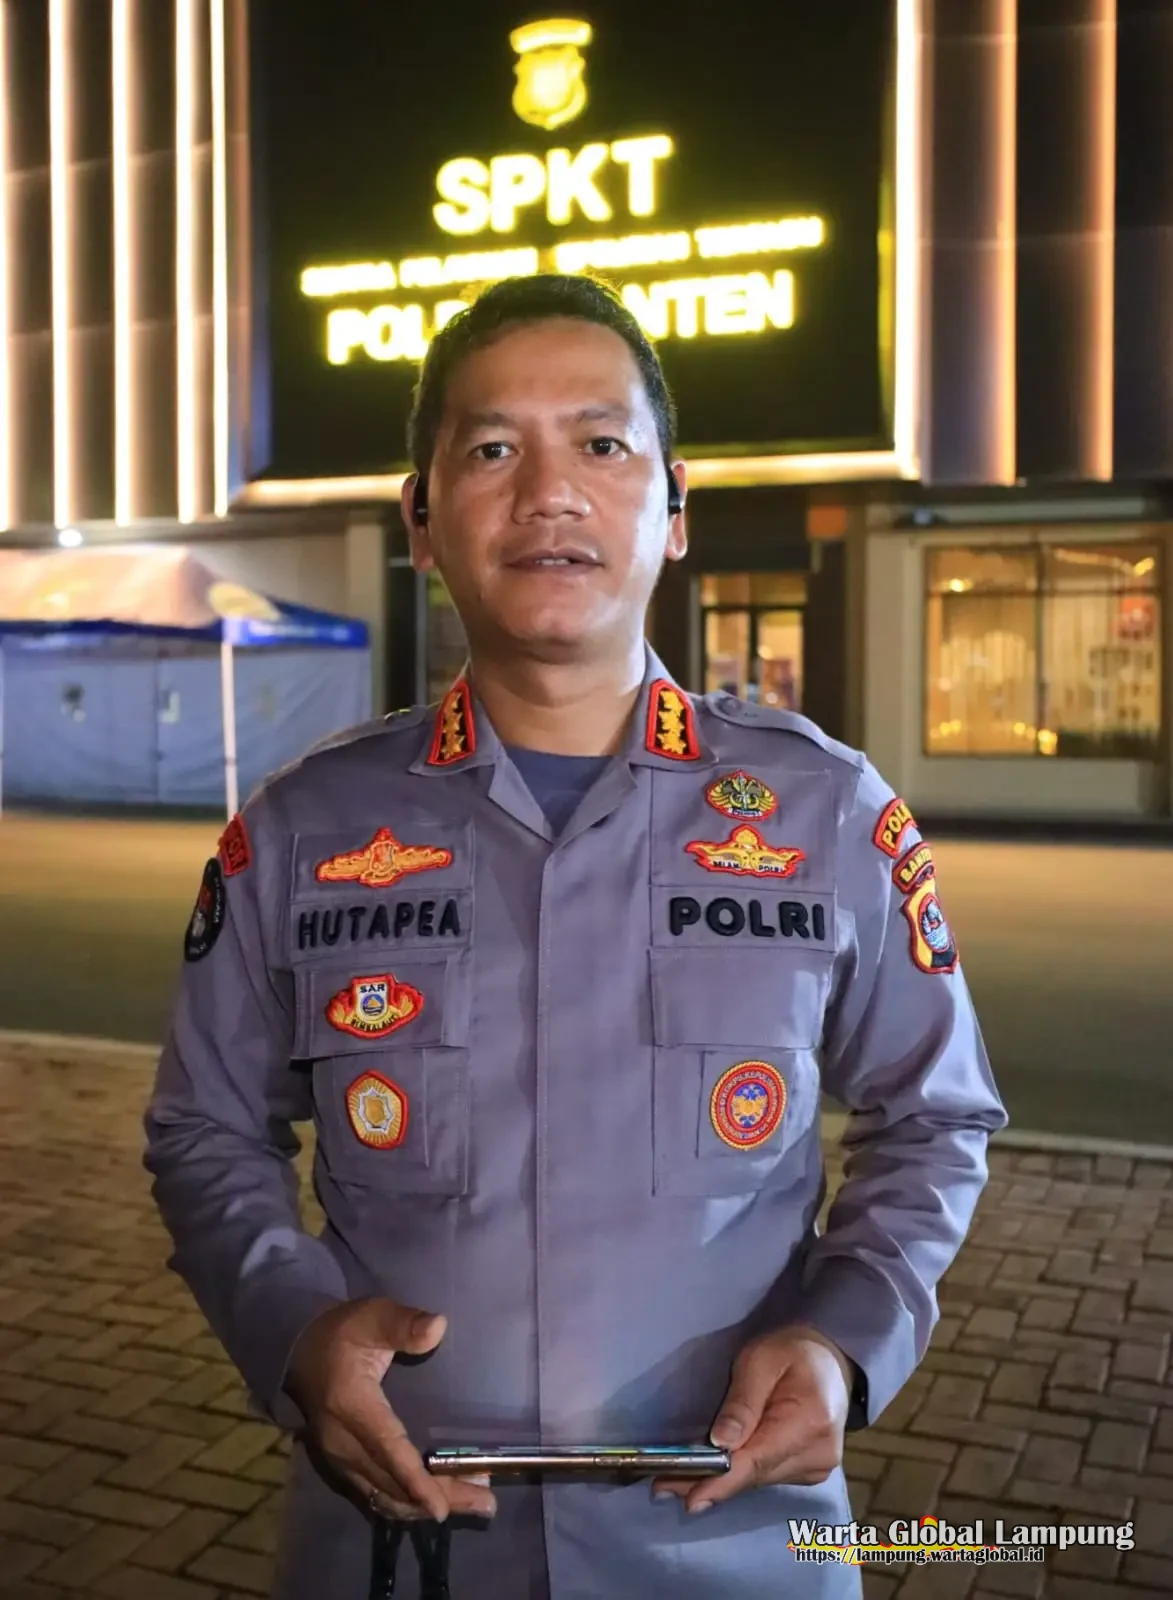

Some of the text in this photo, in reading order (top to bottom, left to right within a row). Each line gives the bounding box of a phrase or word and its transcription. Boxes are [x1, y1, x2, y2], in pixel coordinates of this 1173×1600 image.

[432, 134, 674, 236] SPKT
[298, 896, 462, 950] HUTAPEA
[668, 896, 826, 941] POLRI
[359, 983, 385, 993] SAR
